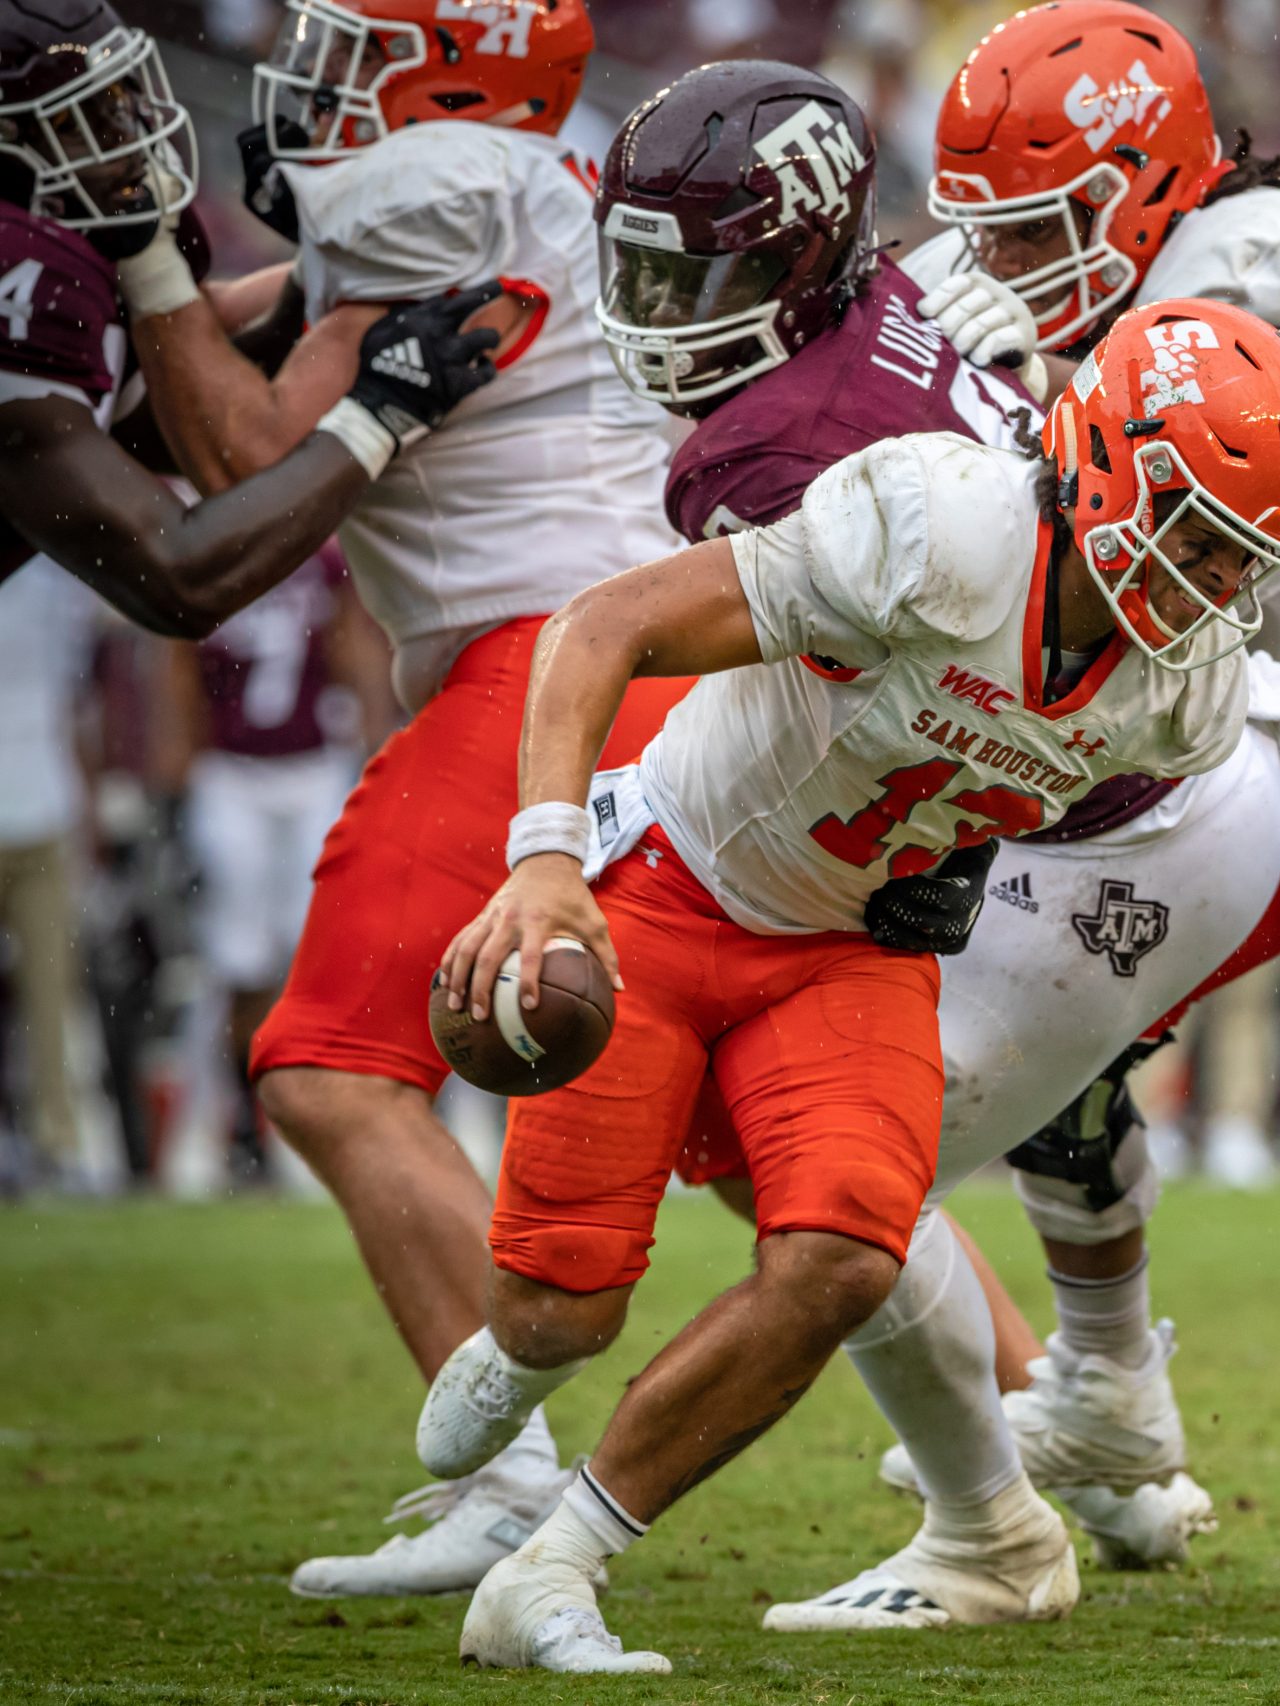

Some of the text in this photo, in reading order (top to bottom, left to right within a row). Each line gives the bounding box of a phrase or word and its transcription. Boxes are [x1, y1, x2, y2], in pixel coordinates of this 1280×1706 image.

[0, 258, 44, 340] 4
[935, 663, 1018, 717] WAC
[910, 709, 1087, 794] SAM HOUSTON
[988, 884, 1040, 914] adidas
